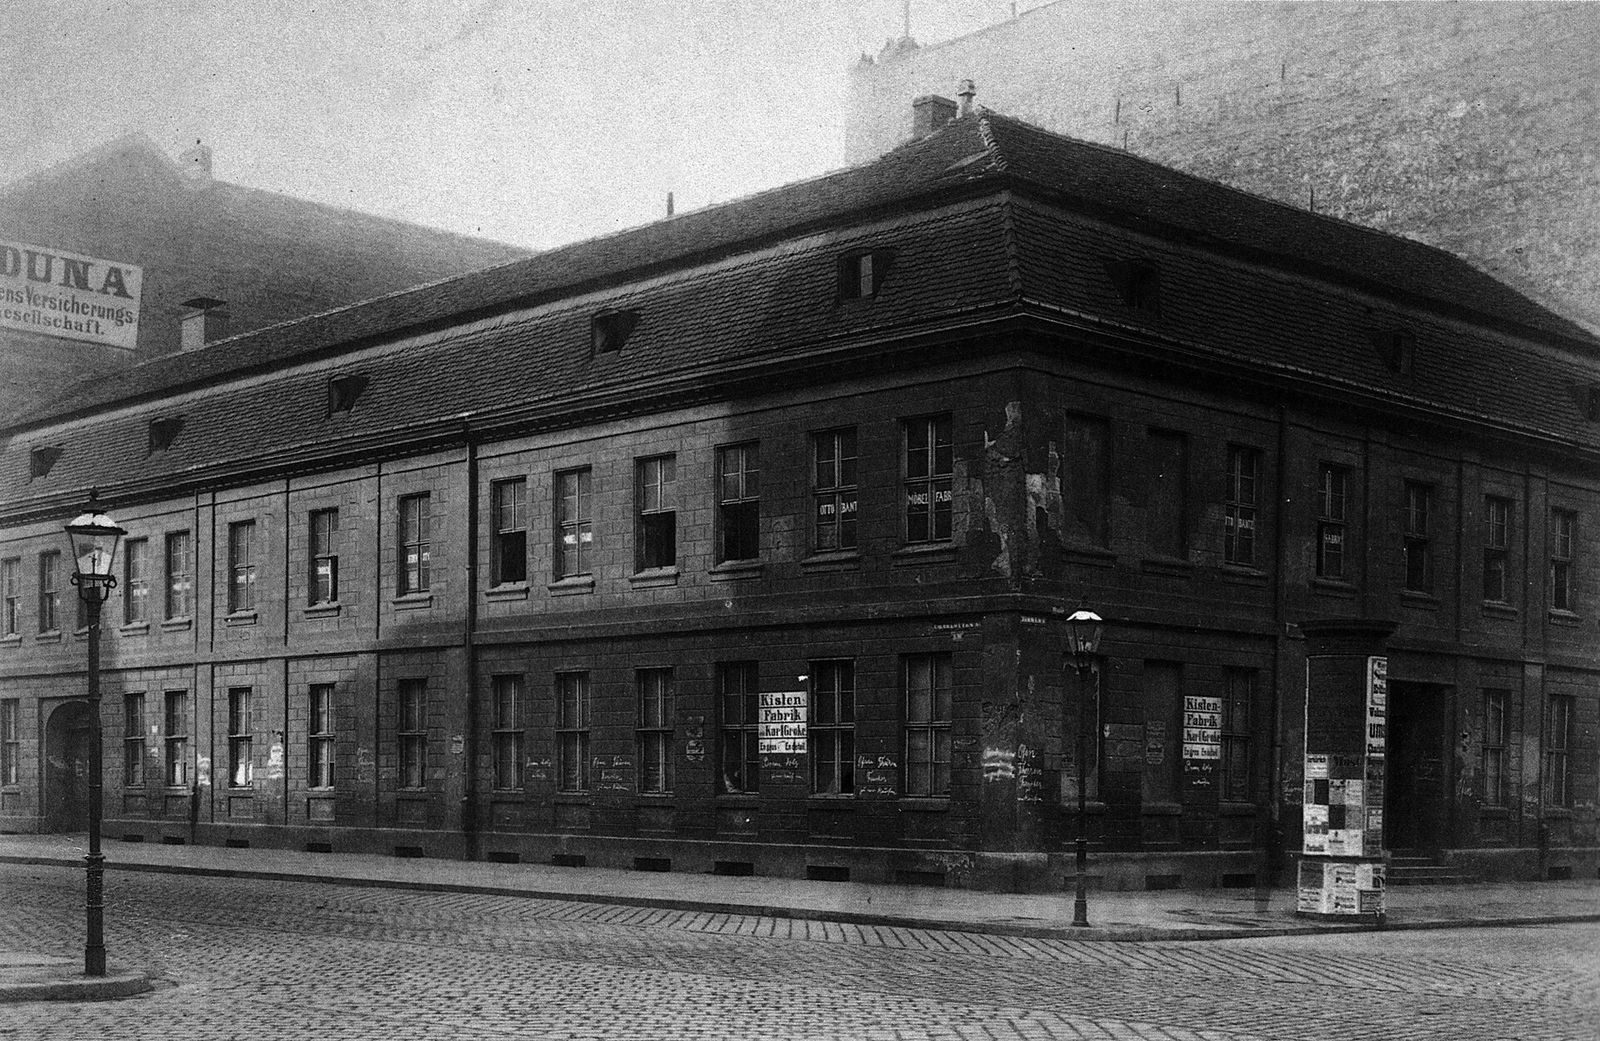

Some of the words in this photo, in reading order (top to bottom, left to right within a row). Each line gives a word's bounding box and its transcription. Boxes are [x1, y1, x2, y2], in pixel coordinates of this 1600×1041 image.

[0, 308, 105, 335] esellschaft.
[819, 503, 835, 516] OTTO
[764, 708, 801, 721] Fabrik
[1187, 714, 1218, 727] Fabrik
